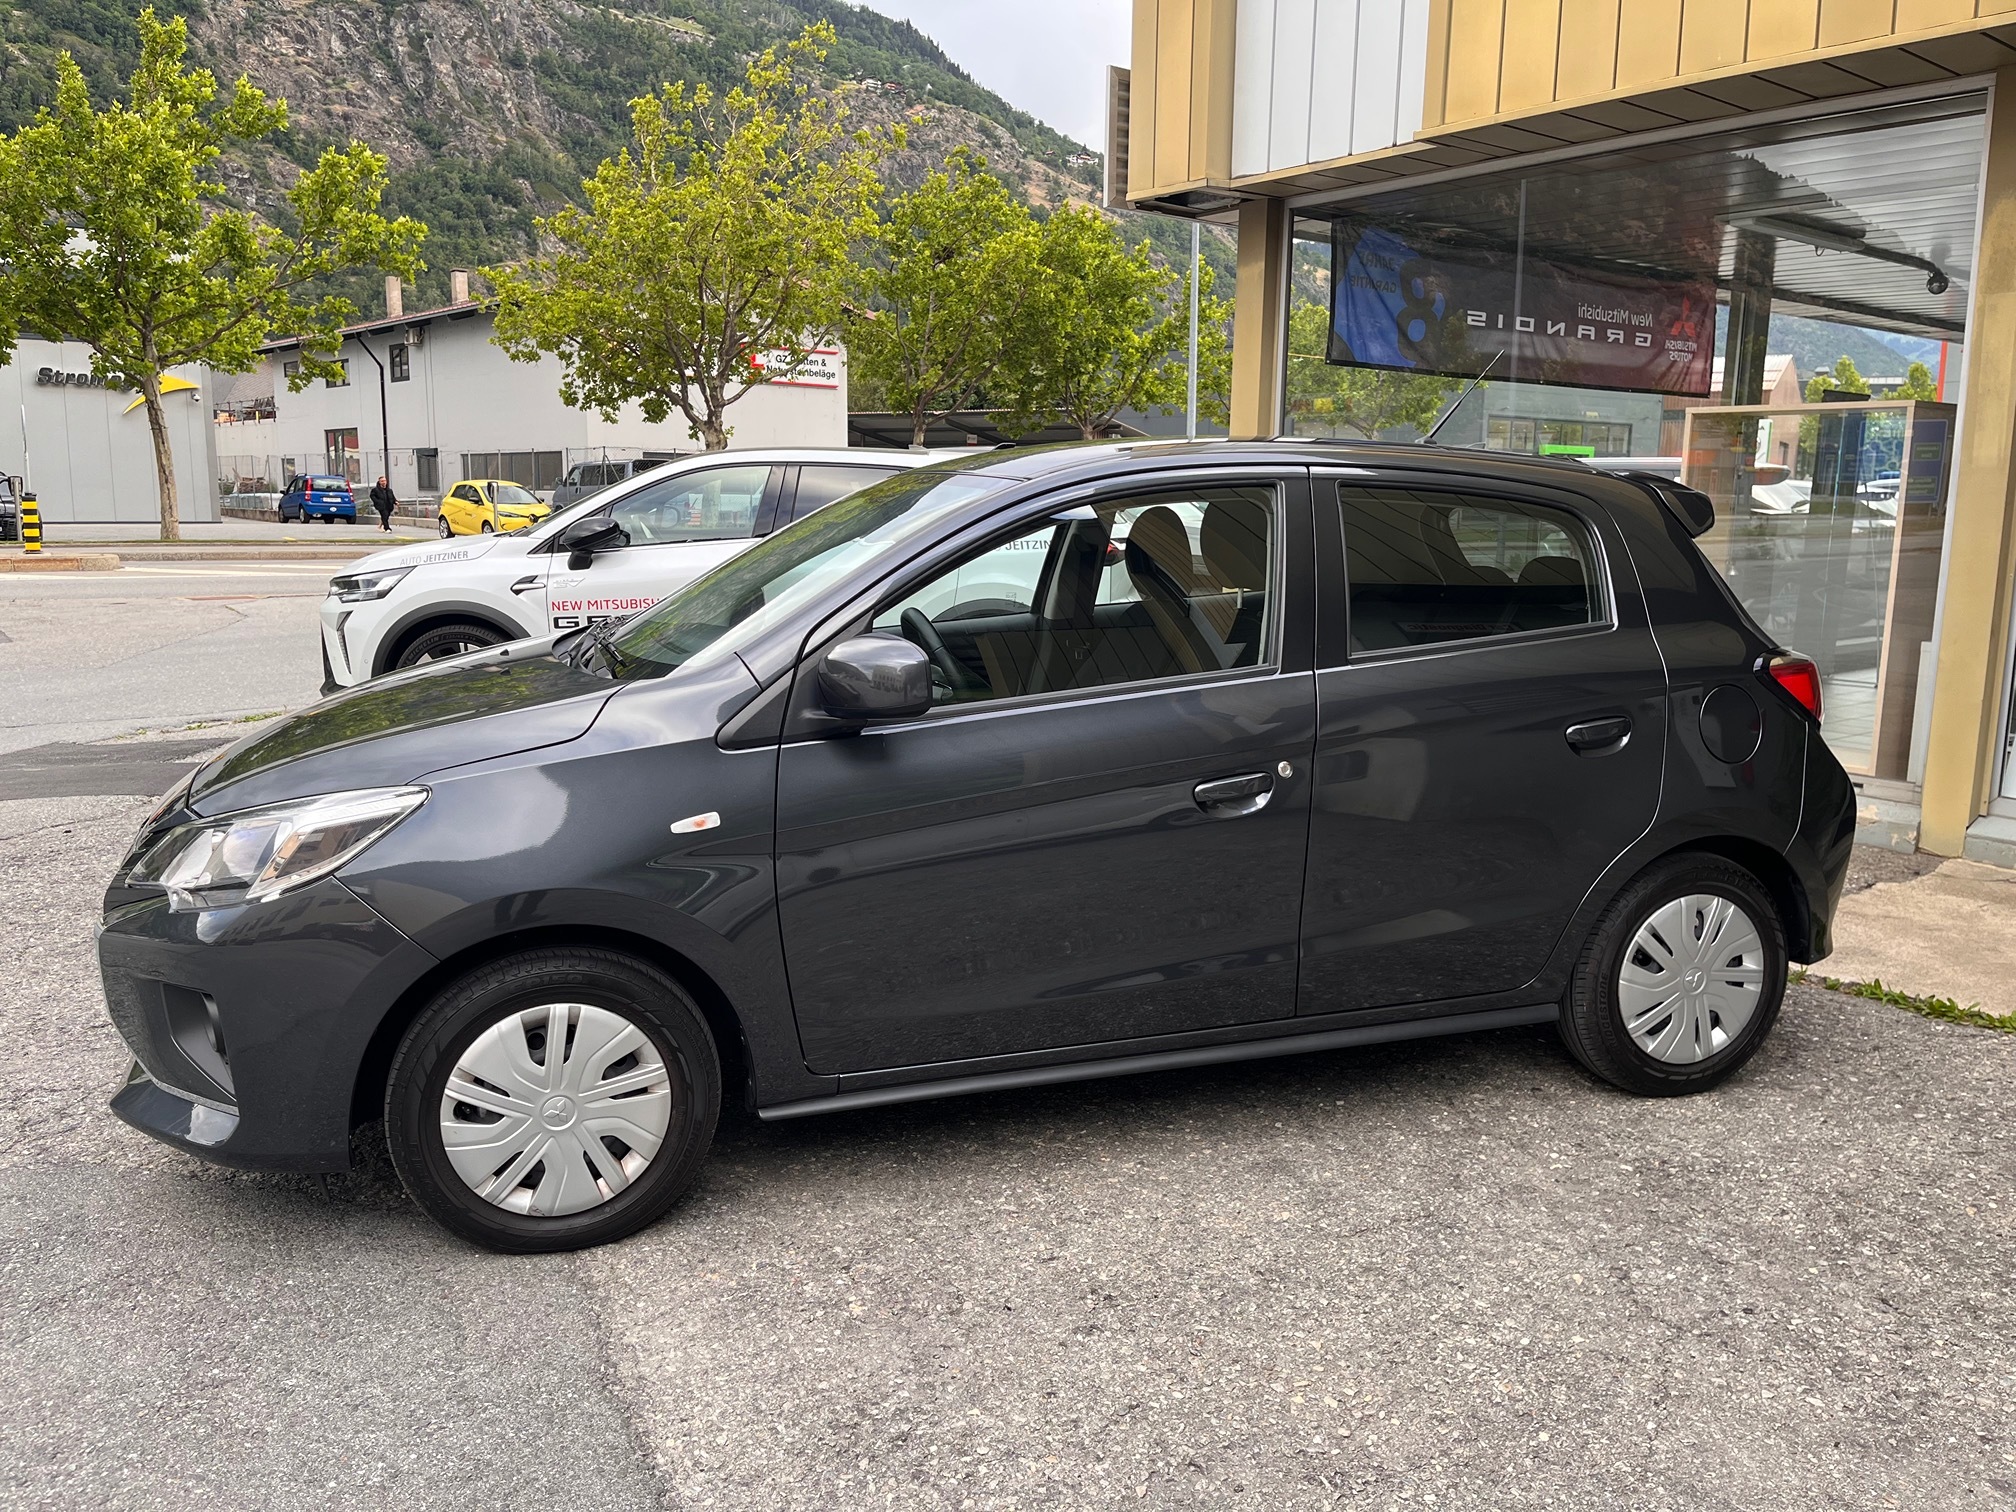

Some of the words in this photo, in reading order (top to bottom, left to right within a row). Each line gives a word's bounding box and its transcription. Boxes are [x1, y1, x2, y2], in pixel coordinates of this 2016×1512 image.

[400, 555, 422, 566] AUTO
[423, 550, 469, 564] JEITZINER
[551, 600, 583, 612] NEW
[1598, 972, 1621, 1053] RIDGESTONE
